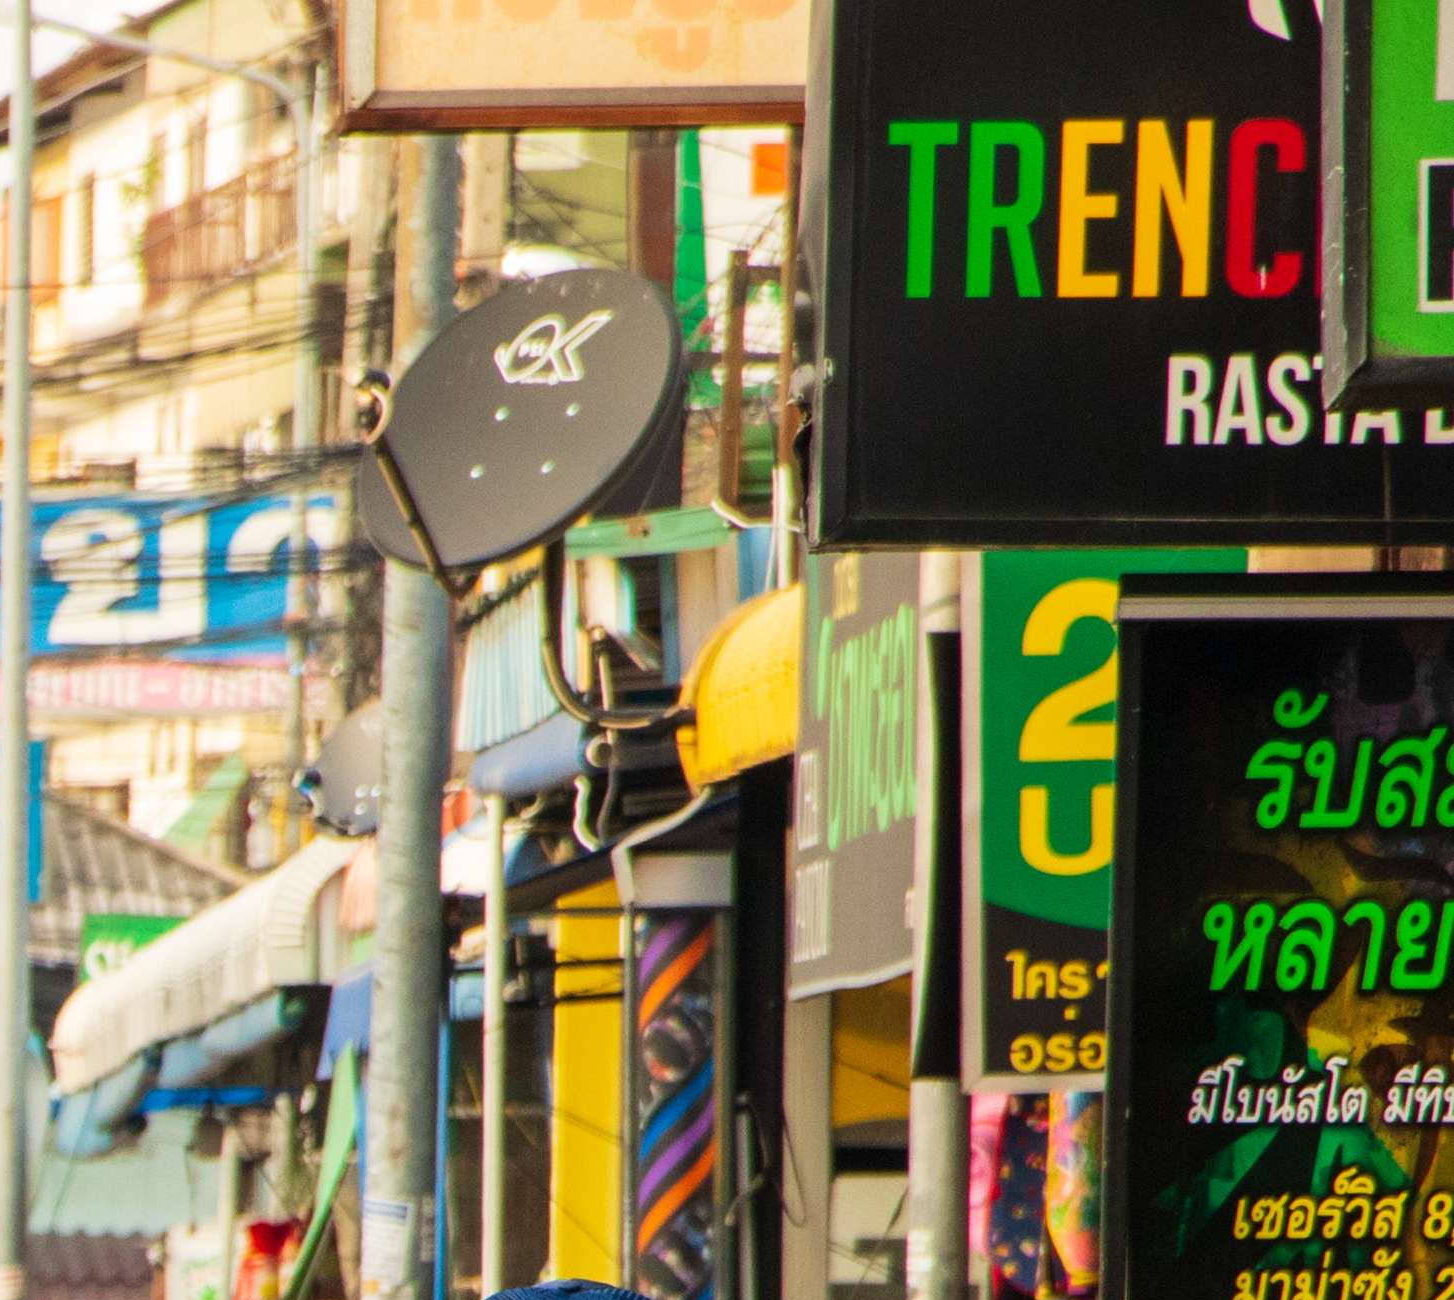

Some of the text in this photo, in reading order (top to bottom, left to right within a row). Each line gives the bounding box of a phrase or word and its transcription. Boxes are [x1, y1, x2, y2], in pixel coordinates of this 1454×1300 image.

[889, 116, 1323, 299] TRENC
[1187, 1055, 1368, 1125] มีโบนัสโต
[1232, 1164, 1409, 1240] เซอร์วิส
